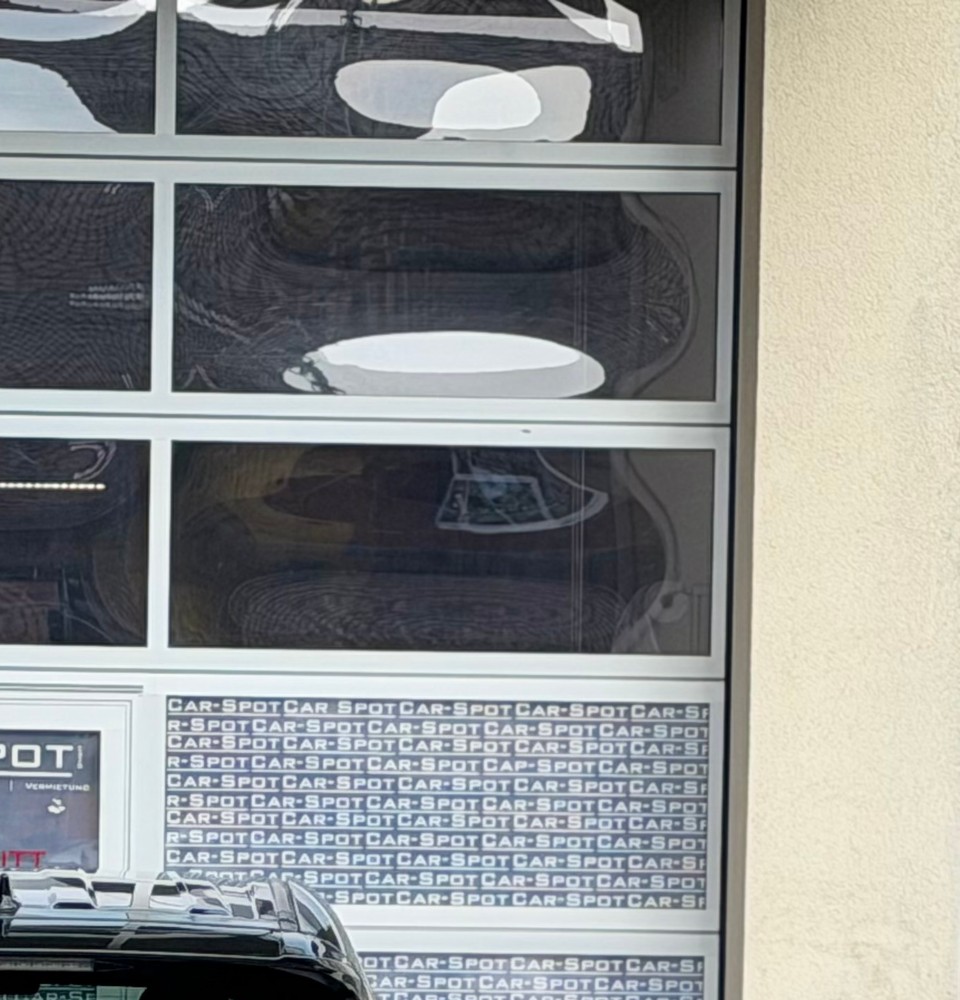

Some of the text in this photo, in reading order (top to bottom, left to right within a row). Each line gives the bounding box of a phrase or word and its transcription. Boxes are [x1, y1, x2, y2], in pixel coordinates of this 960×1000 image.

[168, 699, 280, 712] CAR-SPOT
[399, 702, 511, 716] CAR-SPOT
[514, 704, 627, 717] CAR-SPOT
[251, 720, 595, 736] CAR-SPOT CAR-SPOT CAR-SPOT
[168, 736, 627, 754] CAR-SPOT CAR-SPOT CAR-SPOT CAR-SPOT
[251, 756, 363, 769] CAR-SPOT
[367, 758, 479, 771] CAR-SPOT
[167, 774, 626, 793] CAR-SPOT CAR-SPOT CAR-SPOT CAR-SPOT
[250, 795, 594, 811] CAR-SPOT CAR-SPOT CAR-SPOT
[166, 811, 625, 829] CAR-SPOT CAR-SPOT CAR-SPOT CAR-SPOT
[249, 831, 593, 848] CAR-SPOT CAR-SPOT CAR-SPOT
[166, 849, 625, 868] CAR-SPOT CAR-SPOT CAR-SPOT CAR-SPOT
[365, 872, 593, 887] CAR-SPOT CAR-SPOT
[396, 892, 624, 908] CAR-SPOT CAR-SPOT
[394, 957, 622, 971] CAR-SPOT CAR-SPOT
[478, 977, 591, 990] CAR-SPOT
